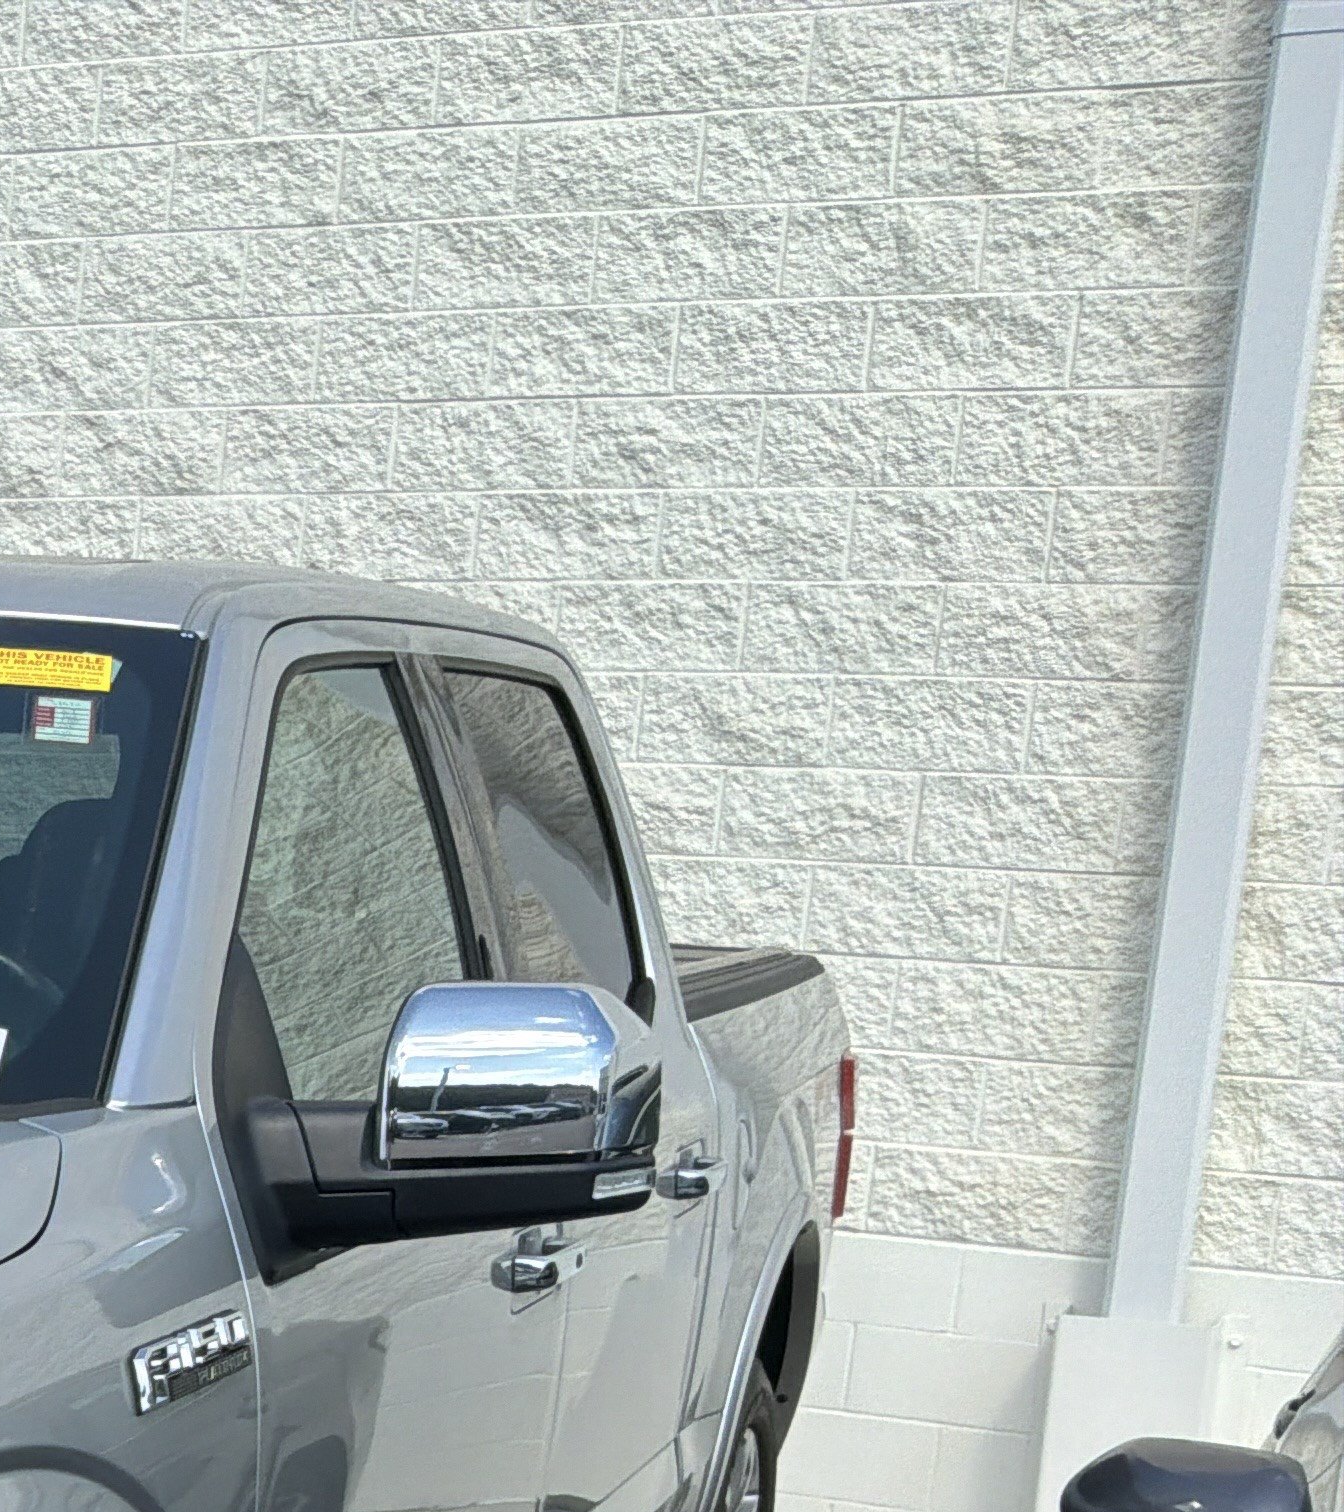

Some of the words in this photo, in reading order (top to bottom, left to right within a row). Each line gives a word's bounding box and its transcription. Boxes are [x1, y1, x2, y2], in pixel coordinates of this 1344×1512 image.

[14, 659, 49, 667] READY
[77, 663, 105, 671] SALE
[34, 652, 106, 666] VEHICLE
